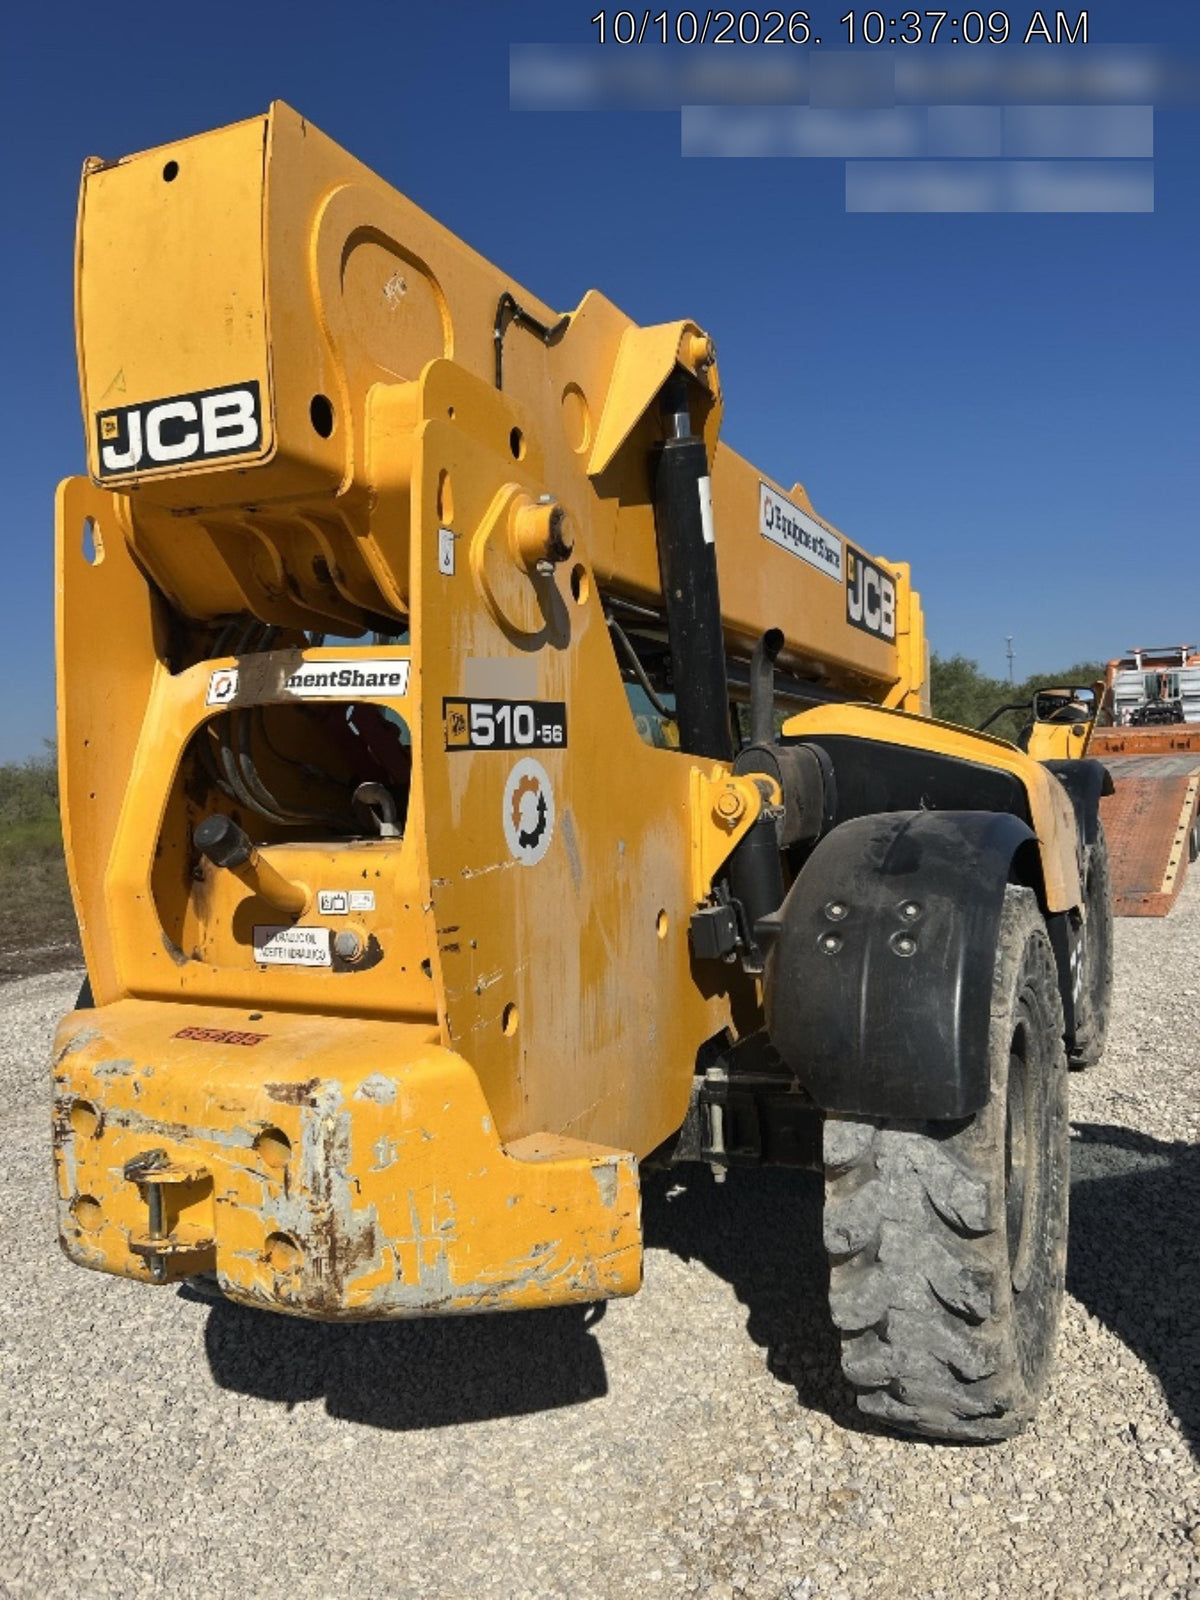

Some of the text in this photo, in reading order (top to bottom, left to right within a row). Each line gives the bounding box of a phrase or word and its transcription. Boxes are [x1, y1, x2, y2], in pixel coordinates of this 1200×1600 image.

[102, 390, 258, 470] JCB
[848, 559, 895, 639] JCB
[285, 669, 401, 688] mentShare
